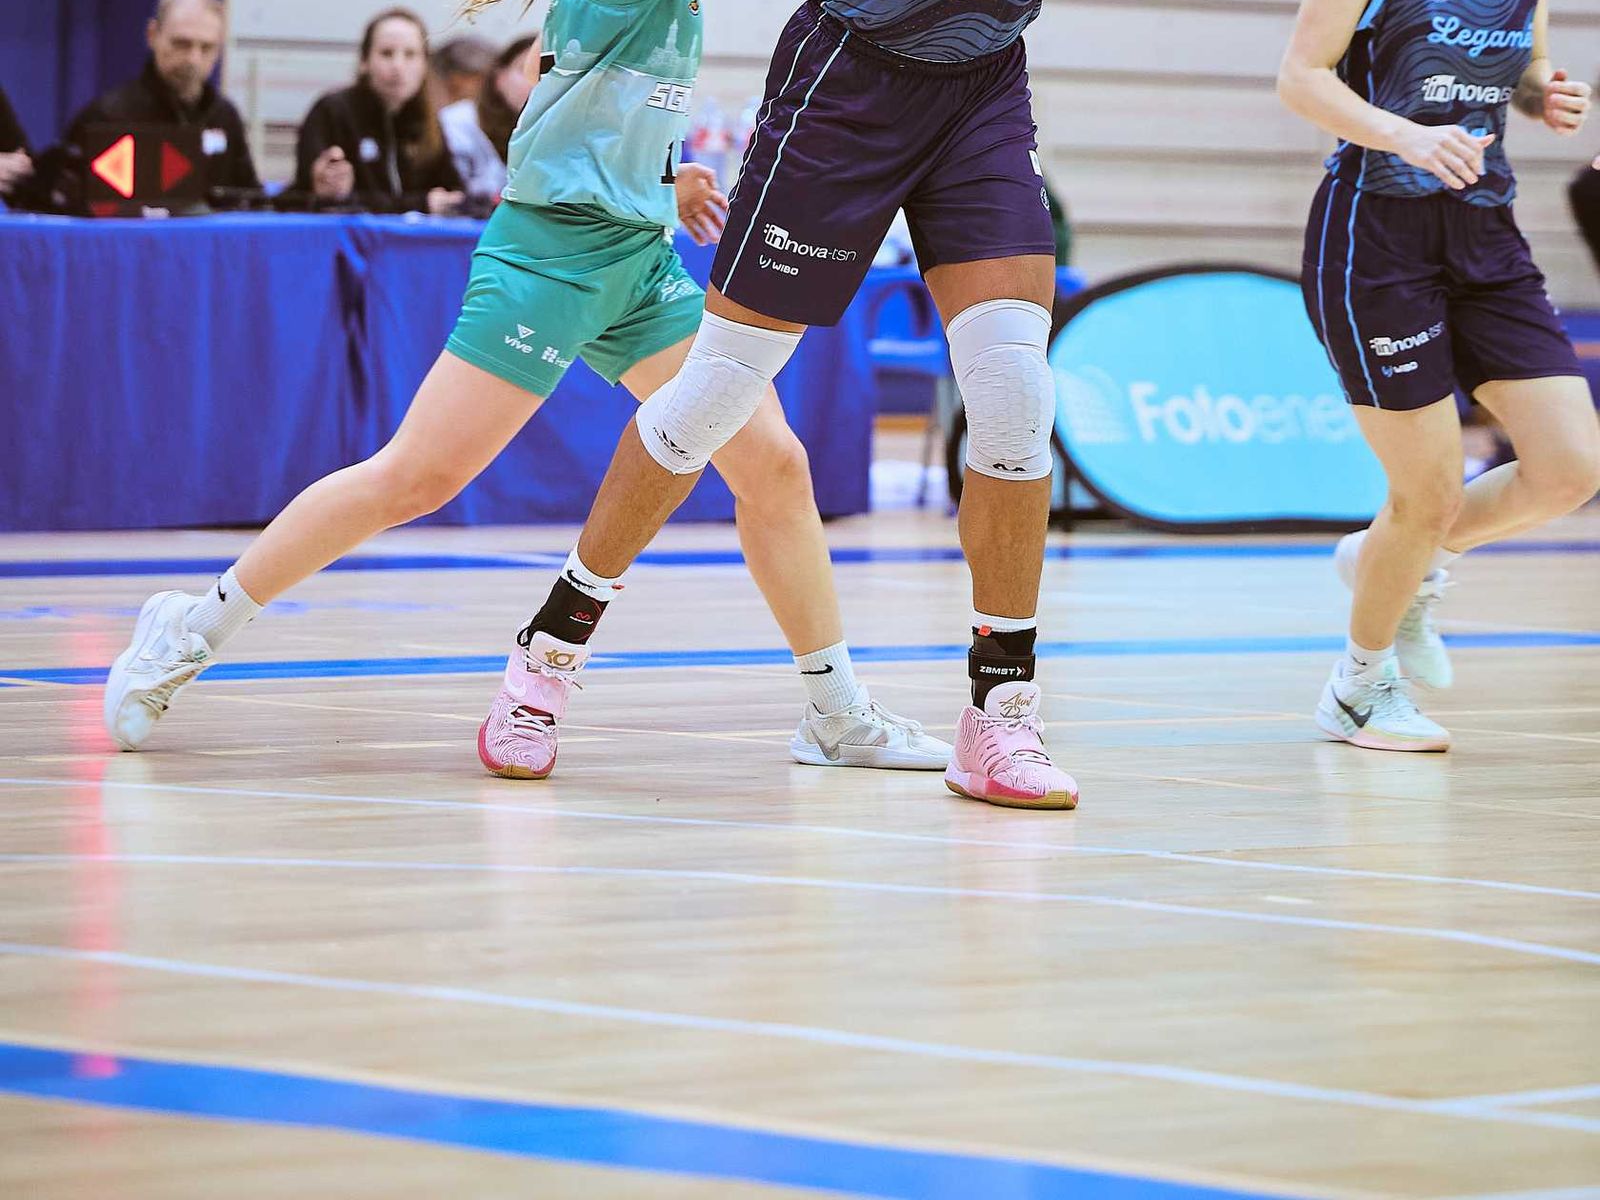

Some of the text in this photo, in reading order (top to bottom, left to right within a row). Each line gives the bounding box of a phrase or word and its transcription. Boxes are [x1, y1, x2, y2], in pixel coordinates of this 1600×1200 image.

[1426, 15, 1533, 57] Legan
[764, 223, 857, 262] innova-tsn
[1128, 381, 1356, 443] Fotoene
